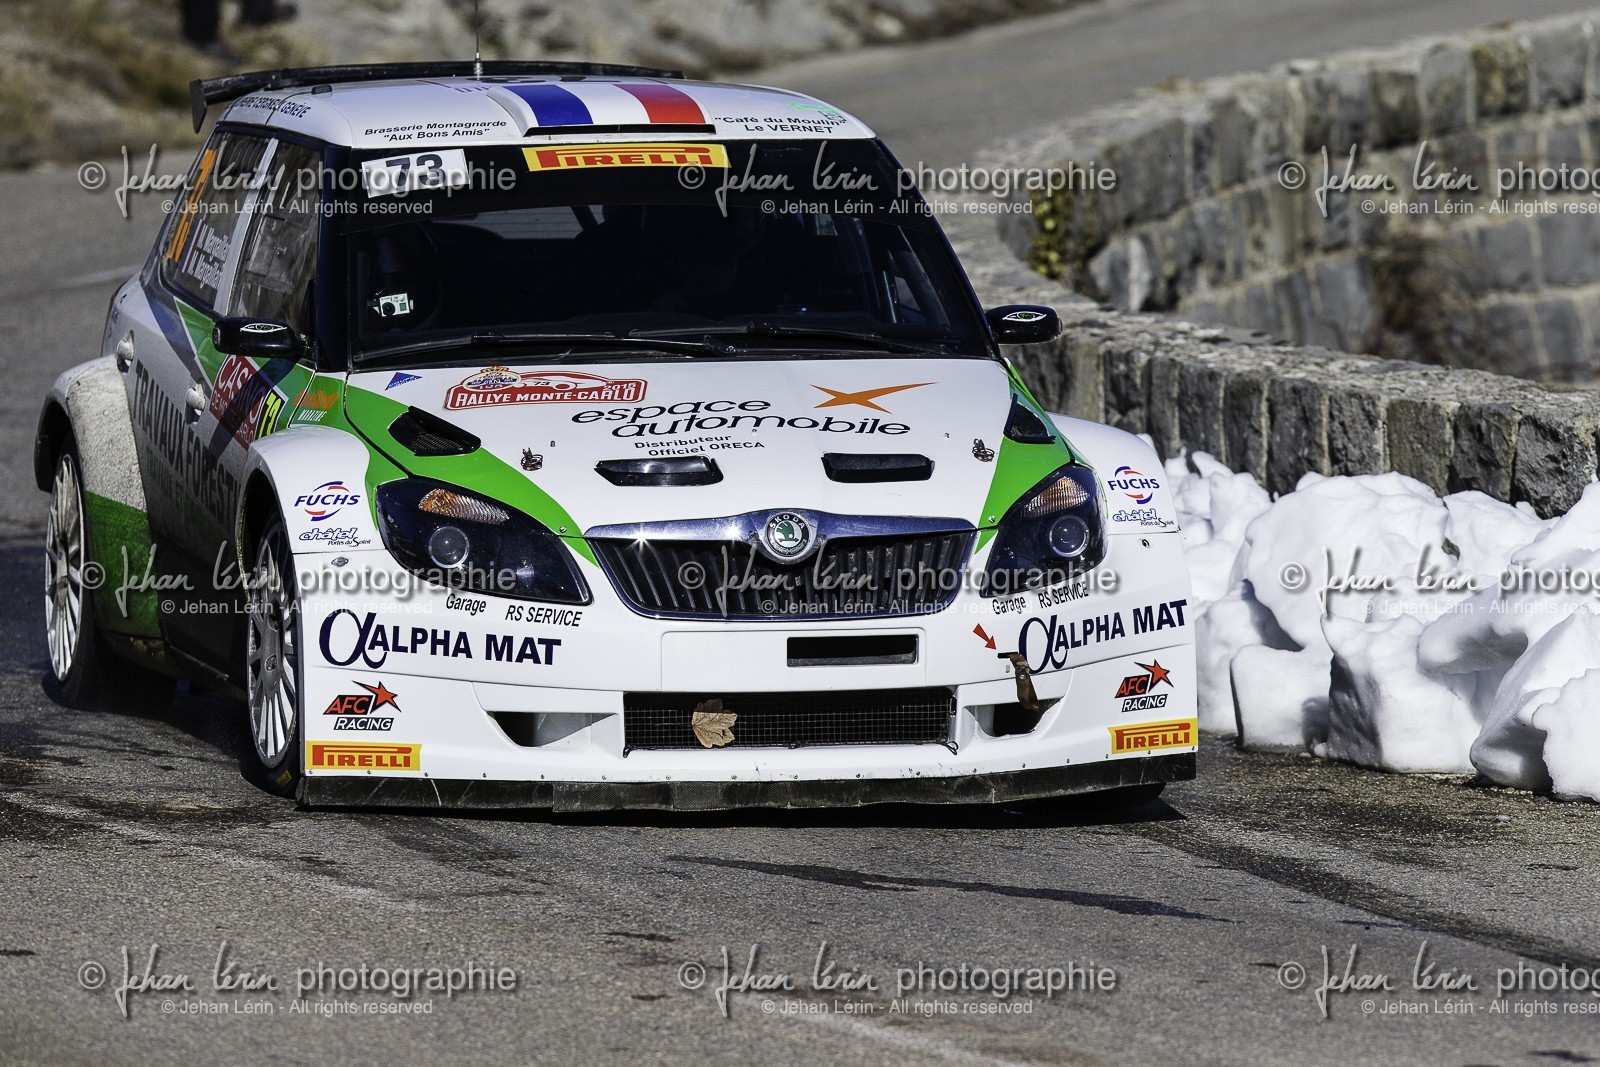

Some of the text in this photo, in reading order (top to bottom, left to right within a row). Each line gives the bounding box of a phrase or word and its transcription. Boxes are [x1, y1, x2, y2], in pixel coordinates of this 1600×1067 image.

[364, 120, 507, 136] Brasserie Montagnarde
[384, 128, 490, 142] "Aux Bons Amis"
[745, 124, 834, 133] Le VERNET
[535, 146, 713, 169] PIRELLI
[385, 154, 446, 187] 73
[455, 387, 636, 407] RALLYE MONTE-CARLO
[133, 358, 187, 478] TRAVAUX
[571, 399, 771, 424] espace
[611, 414, 911, 438] automobile
[634, 435, 732, 449] Distributeur
[648, 441, 765, 457] Officiel ORECA
[1107, 478, 1160, 491] FUCHS
[293, 494, 361, 507] FUCHS
[1112, 508, 1158, 522] châtel
[298, 527, 358, 541] châtel
[993, 582, 1089, 615] Garage RS SERVICE
[445, 593, 583, 628] Garage RS SERVICE
[1054, 599, 1188, 653] ALPHA MAT
[367, 624, 562, 666] ALPHA MAT
[1116, 676, 1148, 697] AFC
[325, 697, 369, 714] AFC
[1122, 695, 1166, 712] RACING
[335, 717, 392, 730] RACING
[1114, 722, 1191, 751] PIRELLI
[312, 745, 413, 768] PIRELLI
